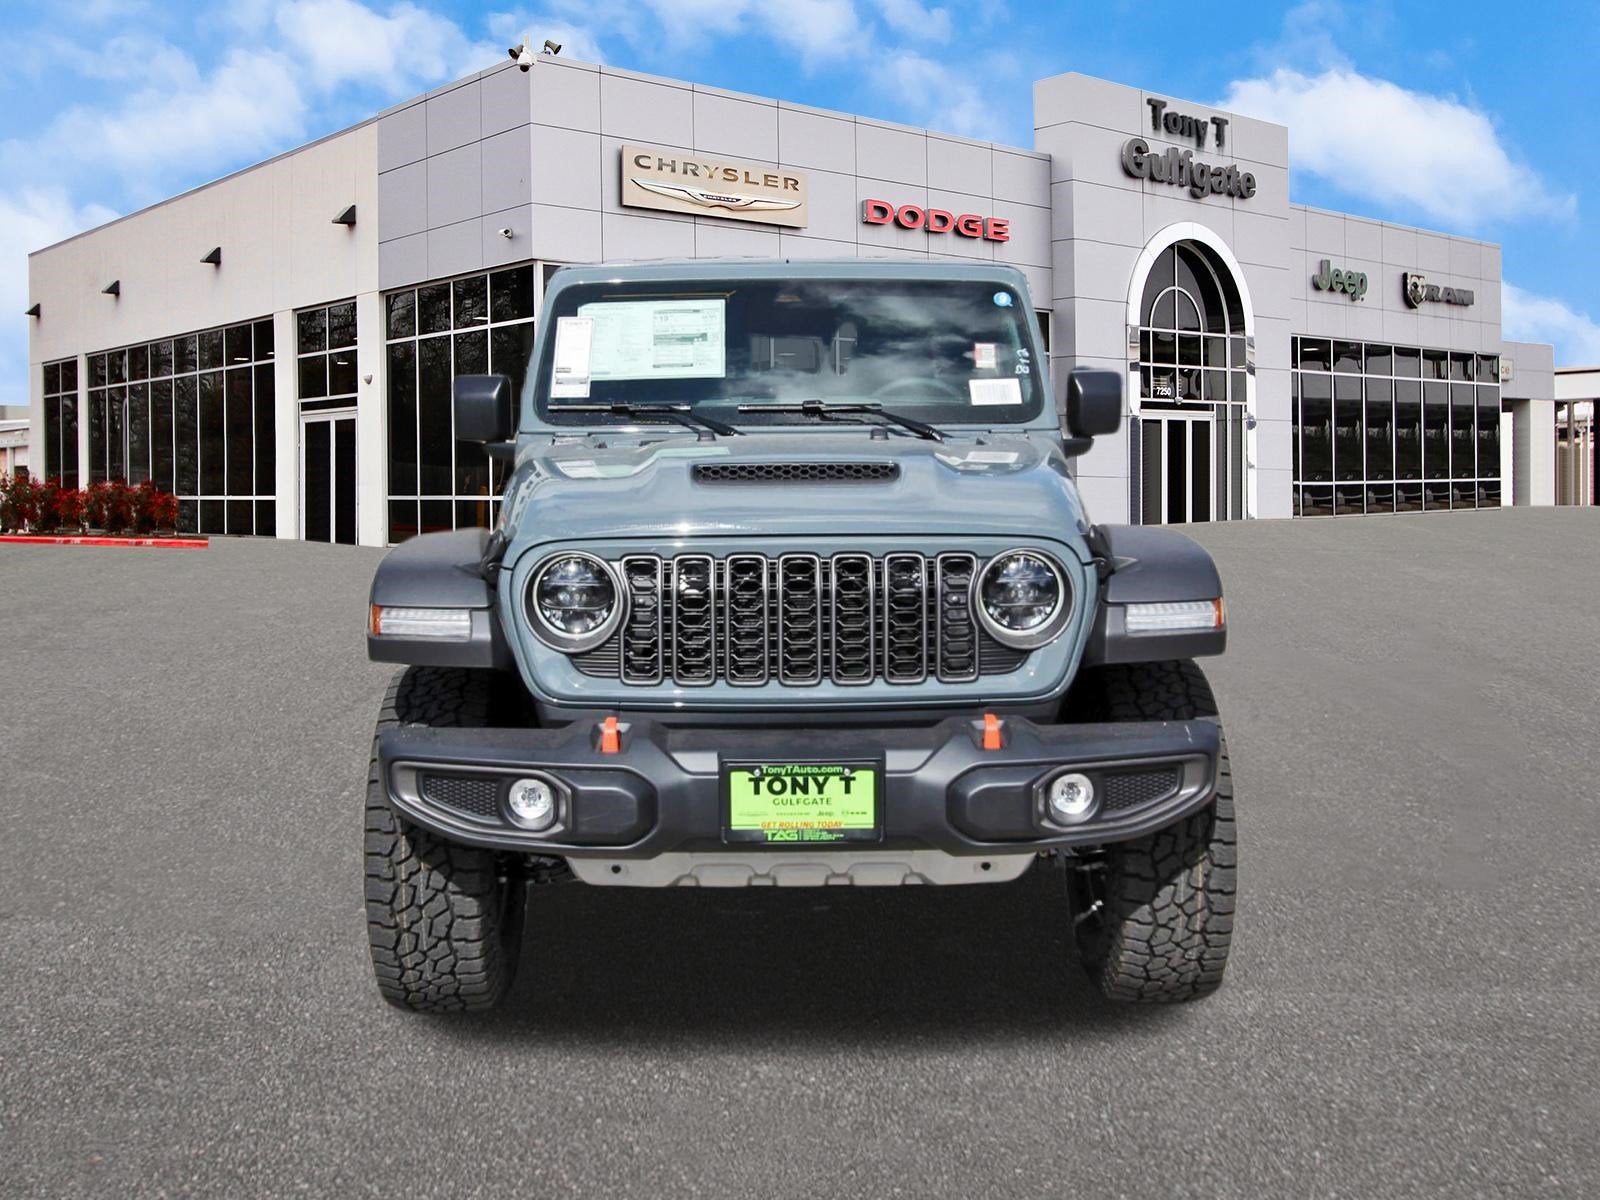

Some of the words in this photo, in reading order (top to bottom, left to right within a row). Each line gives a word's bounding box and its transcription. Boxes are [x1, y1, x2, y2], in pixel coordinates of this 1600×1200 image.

[1146, 98, 1208, 148] Tony
[1210, 116, 1229, 147] T
[633, 154, 801, 191] CHRYSLER
[1122, 137, 1256, 199] Gulfgate
[862, 199, 1010, 241] DODGE
[1312, 259, 1368, 301] Jeep
[1425, 284, 1474, 306] RAM
[1156, 386, 1172, 396] 7250
[761, 764, 843, 776] TonyTAuto.com
[748, 776, 829, 796] TONY
[839, 775, 856, 795] T
[772, 797, 832, 806] GULFGATE
